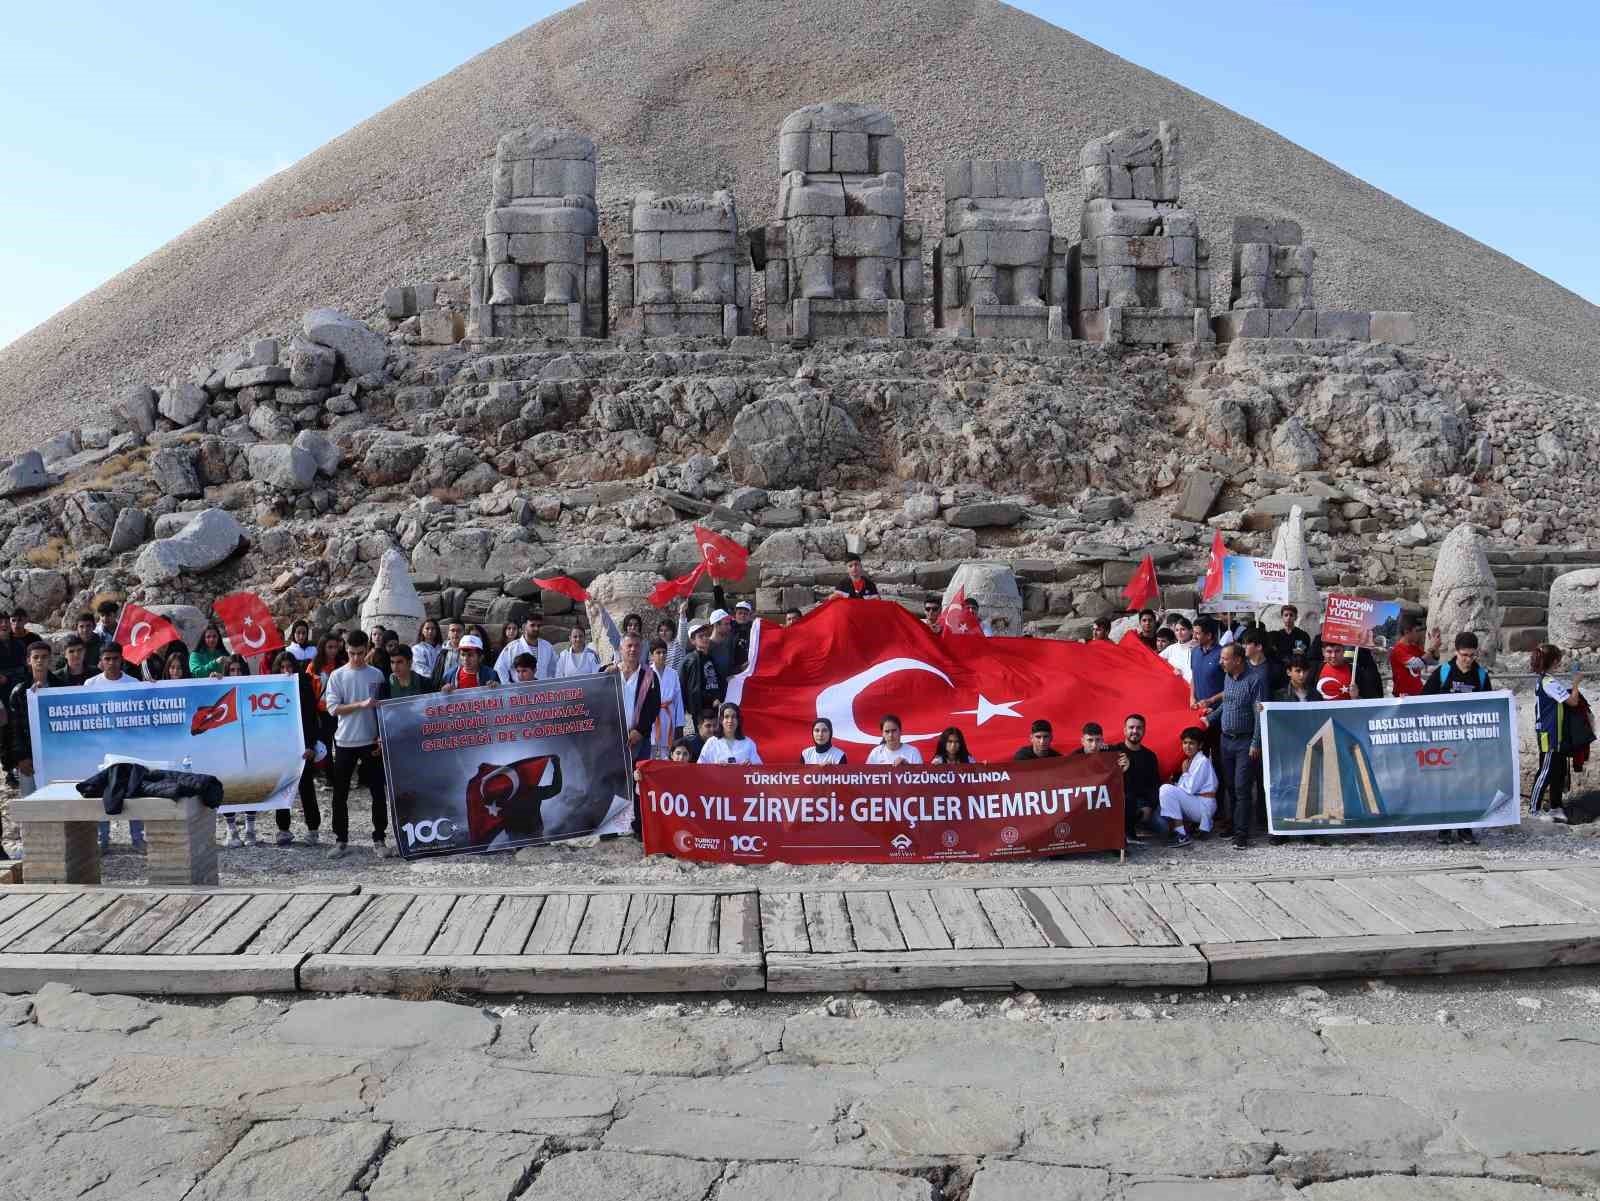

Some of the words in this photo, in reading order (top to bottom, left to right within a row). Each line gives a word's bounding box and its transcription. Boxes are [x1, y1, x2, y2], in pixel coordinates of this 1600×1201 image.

[48, 701, 99, 718] BAŞLASIN
[100, 699, 144, 714] TÜRKİYE
[145, 697, 187, 712] YÜZYILI!
[49, 719, 81, 732] YARIN
[116, 715, 151, 728] HEMEN
[1368, 719, 1416, 732] BAŞLASIN
[1417, 714, 1459, 727] TÜRKİYE
[1460, 711, 1500, 725] YÜZYILI!
[496, 730, 517, 743] DE
[1369, 733, 1400, 745] YARIN
[1432, 729, 1465, 742] HEMEN
[743, 772, 800, 785] TÜRKİYE
[803, 771, 892, 785] CUMHURİYETİ
[894, 770, 956, 785] YÜZÜNCÜ
[958, 771, 1011, 784] YILINDA
[648, 790, 696, 818] 100.
[699, 795, 737, 822] YIL
[742, 792, 845, 822] ZİRVESİ:
[850, 795, 962, 829] GENÇLER
[968, 784, 1112, 820] NEMRUT'TA
